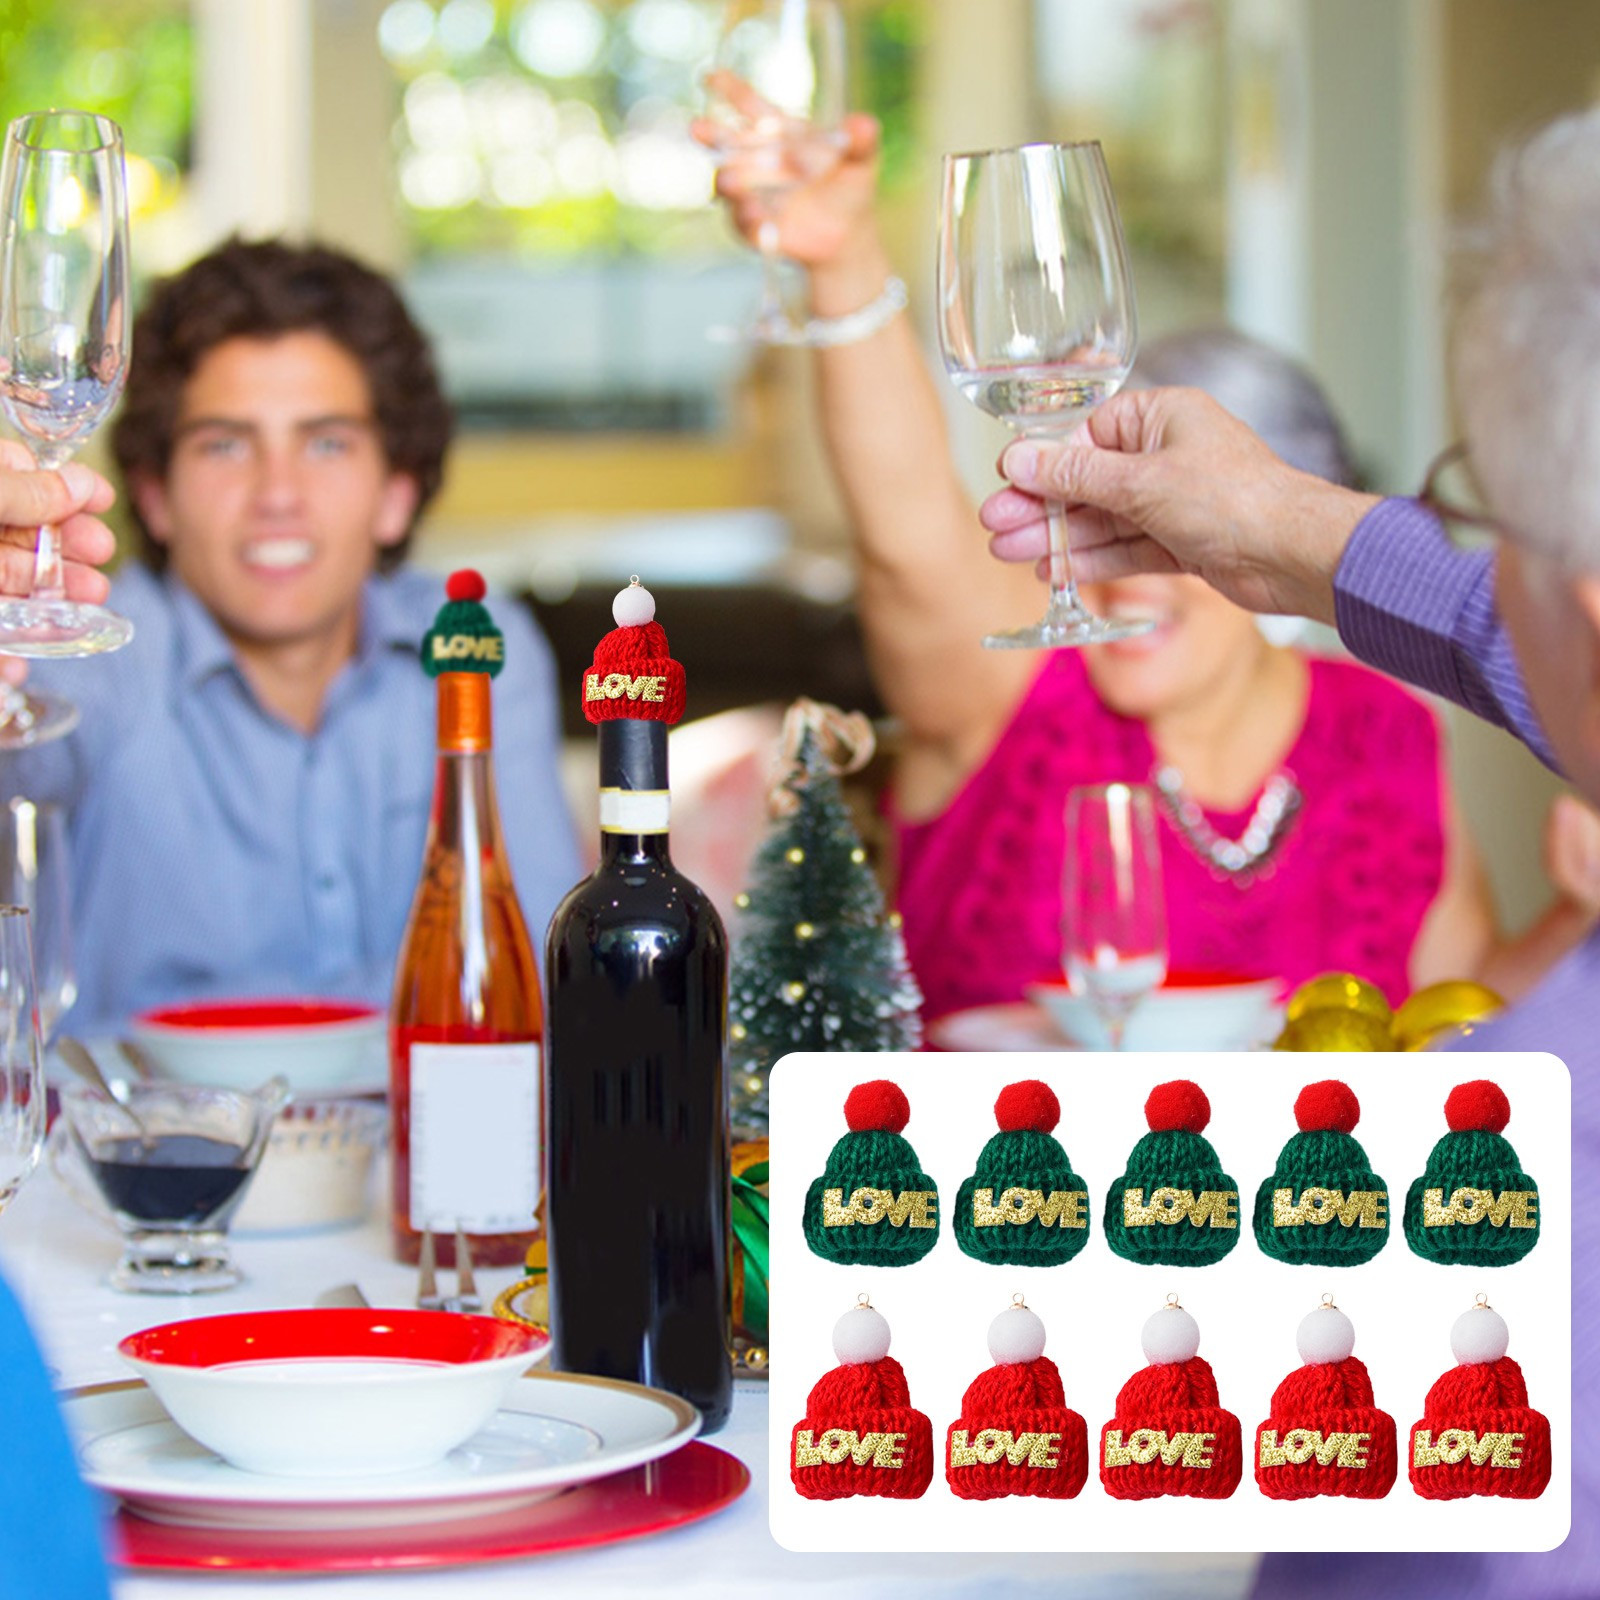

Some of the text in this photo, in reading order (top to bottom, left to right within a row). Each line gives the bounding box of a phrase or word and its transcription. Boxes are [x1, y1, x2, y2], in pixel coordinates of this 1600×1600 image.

[432, 635, 503, 661] LOVE
[586, 673, 666, 702] LOVE
[823, 1187, 936, 1229] LOVE
[973, 1187, 1086, 1229] LOVE
[1123, 1187, 1237, 1229] LOVE
[1273, 1187, 1386, 1229] LOVE
[1423, 1187, 1537, 1229] LOVE
[796, 1429, 906, 1468] LOVE
[951, 1429, 1061, 1468] LOVE
[1105, 1429, 1215, 1468] LOVE
[1260, 1429, 1370, 1468] LOVE
[1414, 1429, 1524, 1468] LOVE
